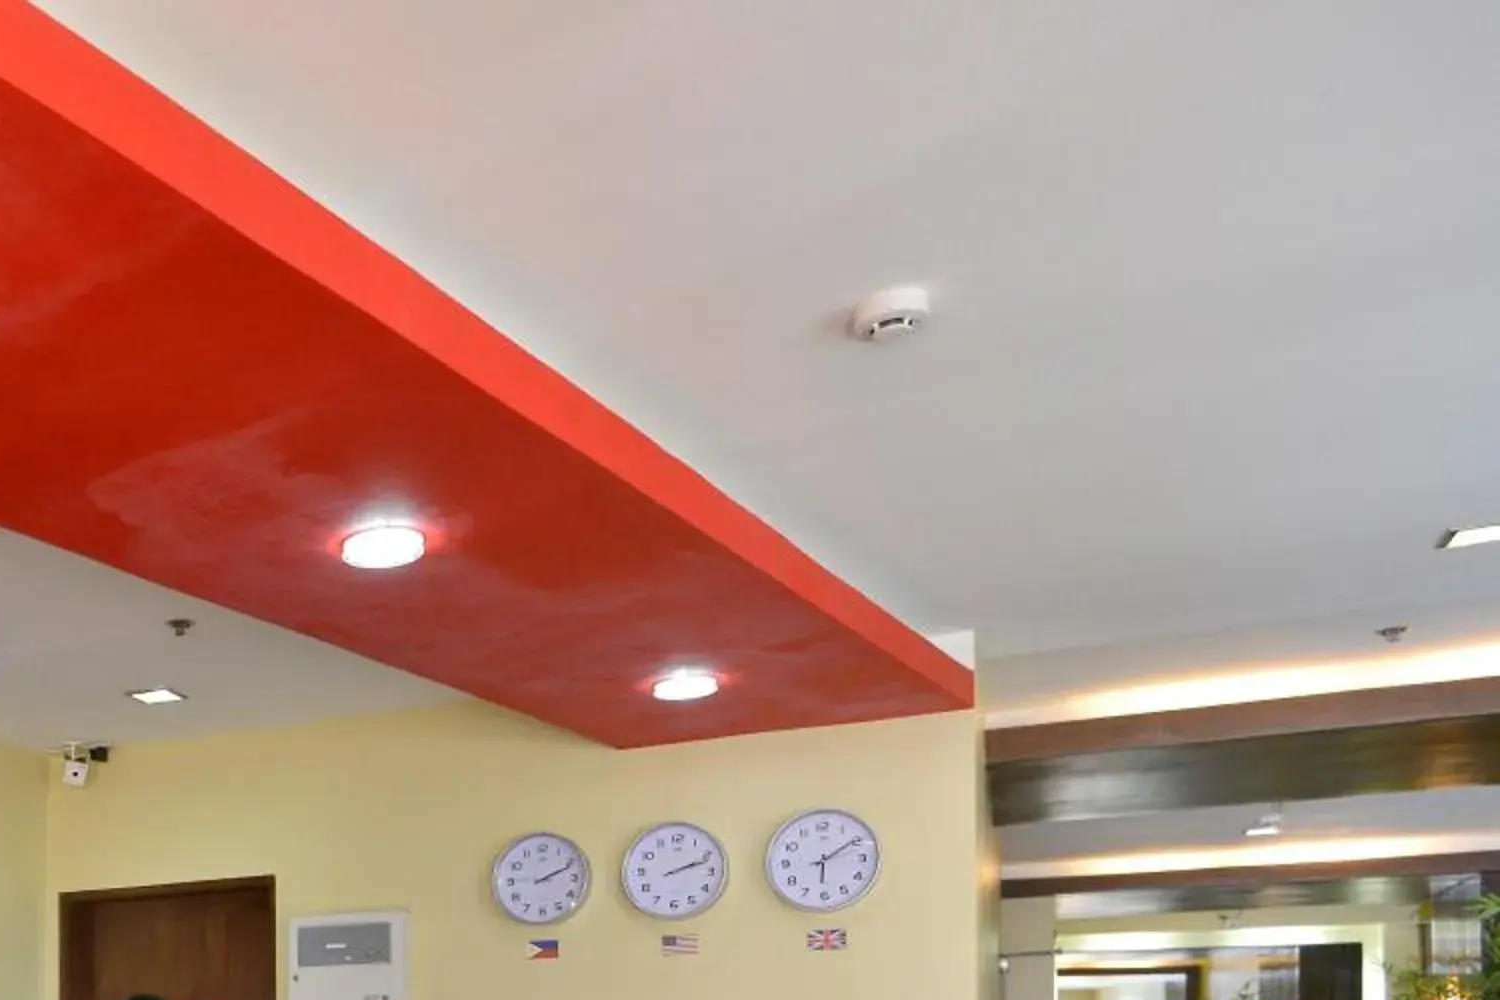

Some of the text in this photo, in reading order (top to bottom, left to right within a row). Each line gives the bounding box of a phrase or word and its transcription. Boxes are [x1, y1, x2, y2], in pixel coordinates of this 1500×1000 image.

[816, 821, 830, 833] 12
[799, 828, 809, 839] 11
[785, 841, 799, 853] 10
[858, 853, 867, 863] 3
[781, 859, 791, 869] 9
[787, 875, 797, 886] 8
[853, 871, 863, 881] 4
[801, 887, 810, 897] 7
[839, 885, 849, 896] 5
[820, 891, 831, 901] 6
